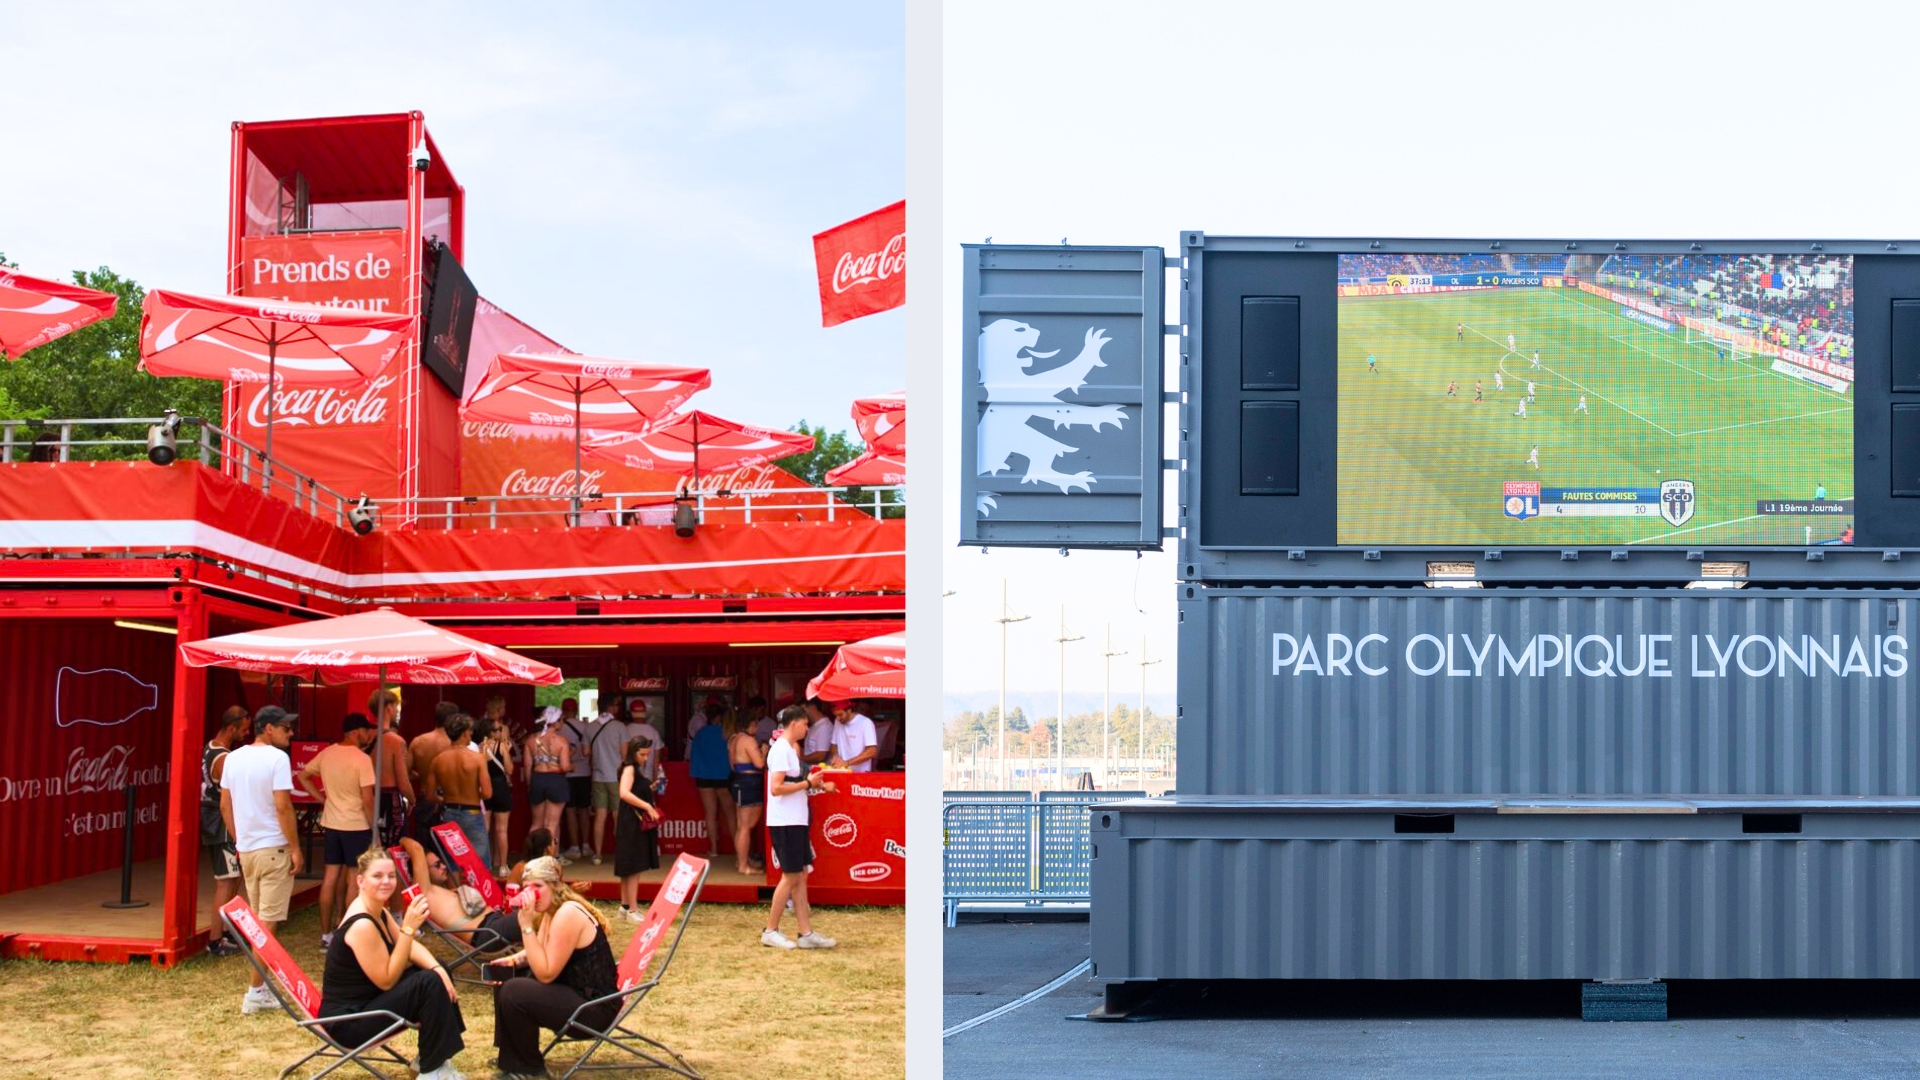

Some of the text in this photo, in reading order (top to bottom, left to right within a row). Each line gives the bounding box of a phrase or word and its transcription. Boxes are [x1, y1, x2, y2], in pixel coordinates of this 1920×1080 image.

[253, 252, 390, 284] Prends de
[1410, 277, 1431, 285] 37:13
[1451, 277, 1460, 285] OL
[1477, 276, 1483, 285] 1
[1492, 276, 1500, 285] 0
[1562, 492, 1638, 500] FAUTES COMMISES
[1556, 505, 1563, 514] 4
[1634, 505, 1647, 514] 10
[1765, 504, 1776, 512] L1
[1272, 633, 1908, 678] PARC OLYMPIQUE LYONNAIS
[853, 785, 881, 798] Better
[866, 867, 885, 875] COLD
